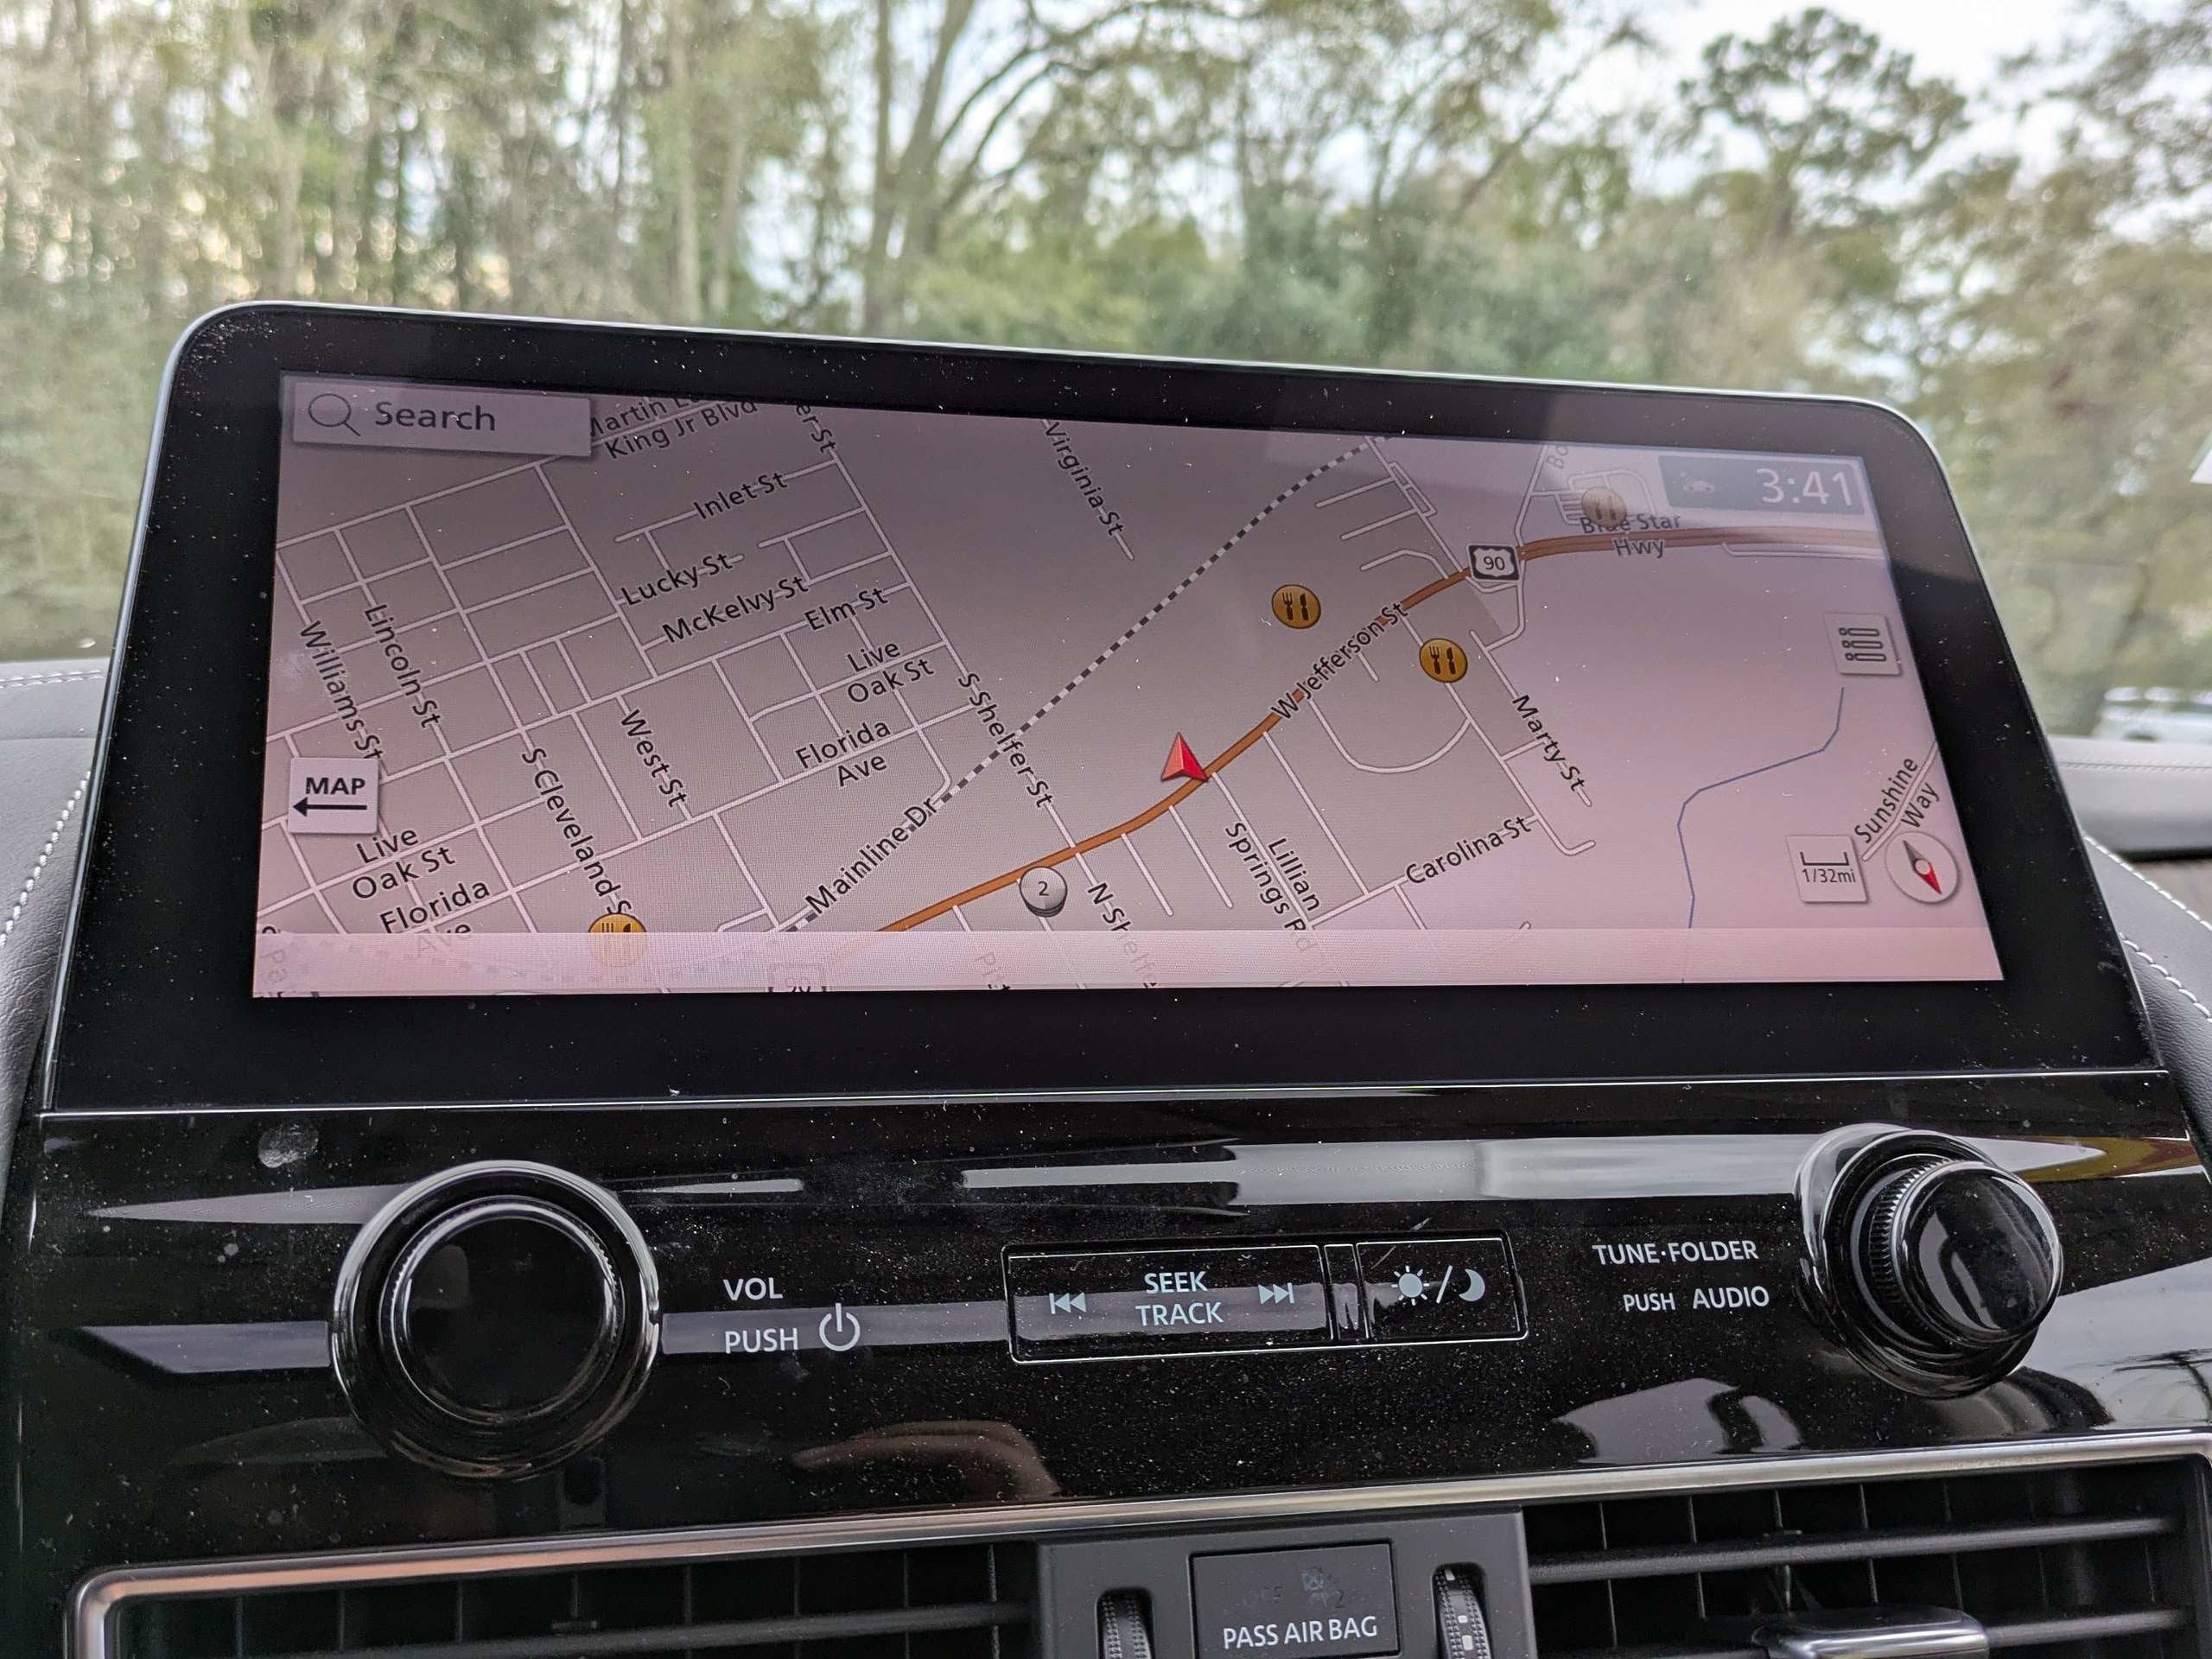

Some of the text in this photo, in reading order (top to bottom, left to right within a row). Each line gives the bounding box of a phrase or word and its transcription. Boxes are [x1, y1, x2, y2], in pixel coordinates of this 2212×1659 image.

[375, 400, 496, 432] Search
[605, 402, 758, 460] King Jr Blvd
[810, 429, 836, 453] St
[693, 472, 788, 520] Inlet St
[1044, 421, 1126, 537] Virginia St
[1755, 467, 1853, 507] 3:41
[1636, 513, 1681, 531] Star
[1482, 554, 1505, 572] 90
[1612, 537, 1664, 559] Hwy
[620, 552, 734, 607] Lucky St
[663, 575, 810, 644] McKelvy St
[804, 587, 888, 632] Elm St
[363, 603, 442, 728] Lincoln St
[847, 640, 901, 674] Live
[1271, 602, 1409, 721] W Jefferson St
[299, 620, 382, 760] Williams St
[847, 658, 935, 704] Oak St
[620, 709, 689, 808] West St
[795, 719, 892, 770] Florida
[958, 672, 1053, 809] S Shelfer St
[1510, 694, 1587, 794] Marty St
[304, 777, 366, 796] MAP
[836, 752, 888, 788] Ave
[1854, 755, 1919, 844] Sunshine
[1901, 781, 1941, 830] Way
[356, 828, 420, 864] Live
[522, 747, 632, 914] S Cleveland S
[1405, 813, 1533, 887] Carolina St
[352, 845, 456, 899] Oak St
[804, 796, 938, 916] Mainline Dr
[1224, 822, 1292, 916] Springs
[1267, 836, 1322, 912] Lillian
[1801, 868, 1857, 887] 1/32mi
[379, 879, 492, 934] Florida
[1037, 880, 1051, 897] 2
[1087, 882, 1114, 906] N
[722, 1277, 784, 1301] VOL
[1143, 1270, 1208, 1294] SEEK
[1623, 1285, 1770, 1313] PUSH AUDIO
[1135, 1302, 1224, 1327] TRACK
[724, 1327, 798, 1354] PUSH
[1223, 1615, 1378, 1649] PASS AIR BAG
